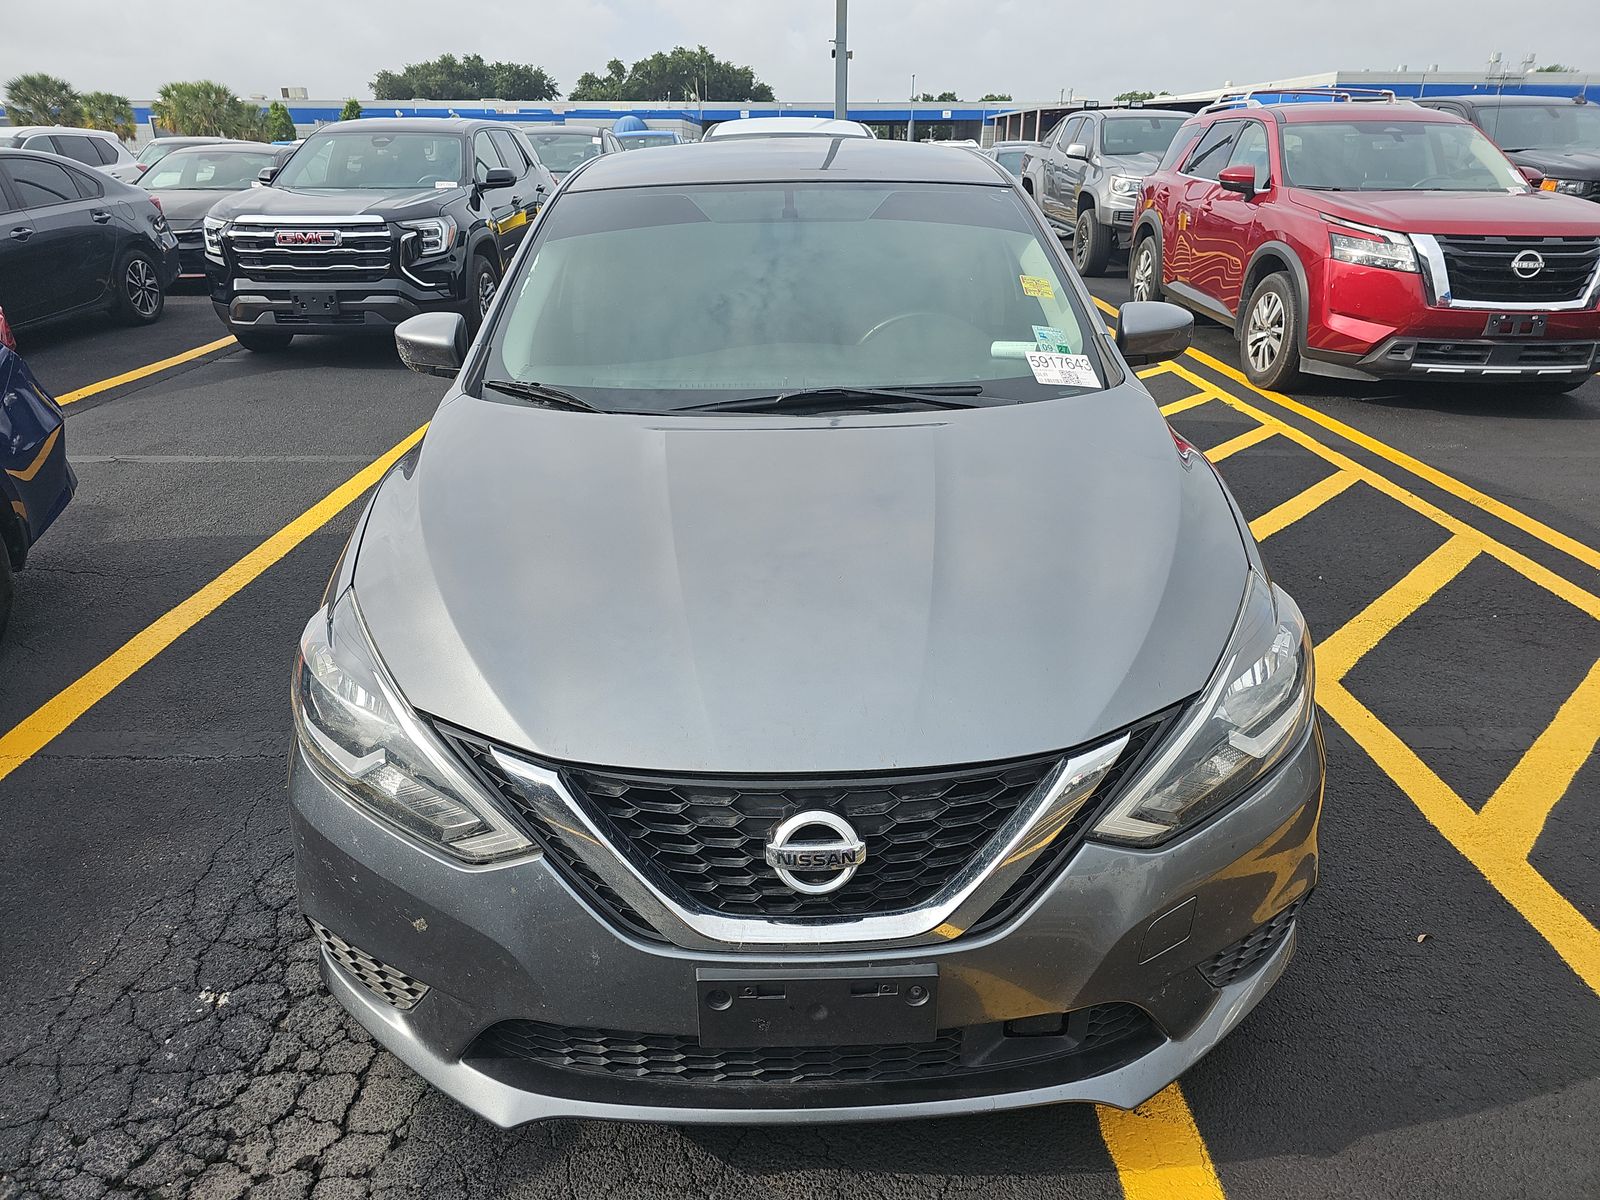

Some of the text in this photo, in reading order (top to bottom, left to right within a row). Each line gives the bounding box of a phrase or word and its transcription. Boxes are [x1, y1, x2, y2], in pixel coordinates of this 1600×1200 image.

[278, 232, 335, 244] GMC
[1030, 355, 1092, 371] 5917643
[776, 850, 857, 867] NISSAN
